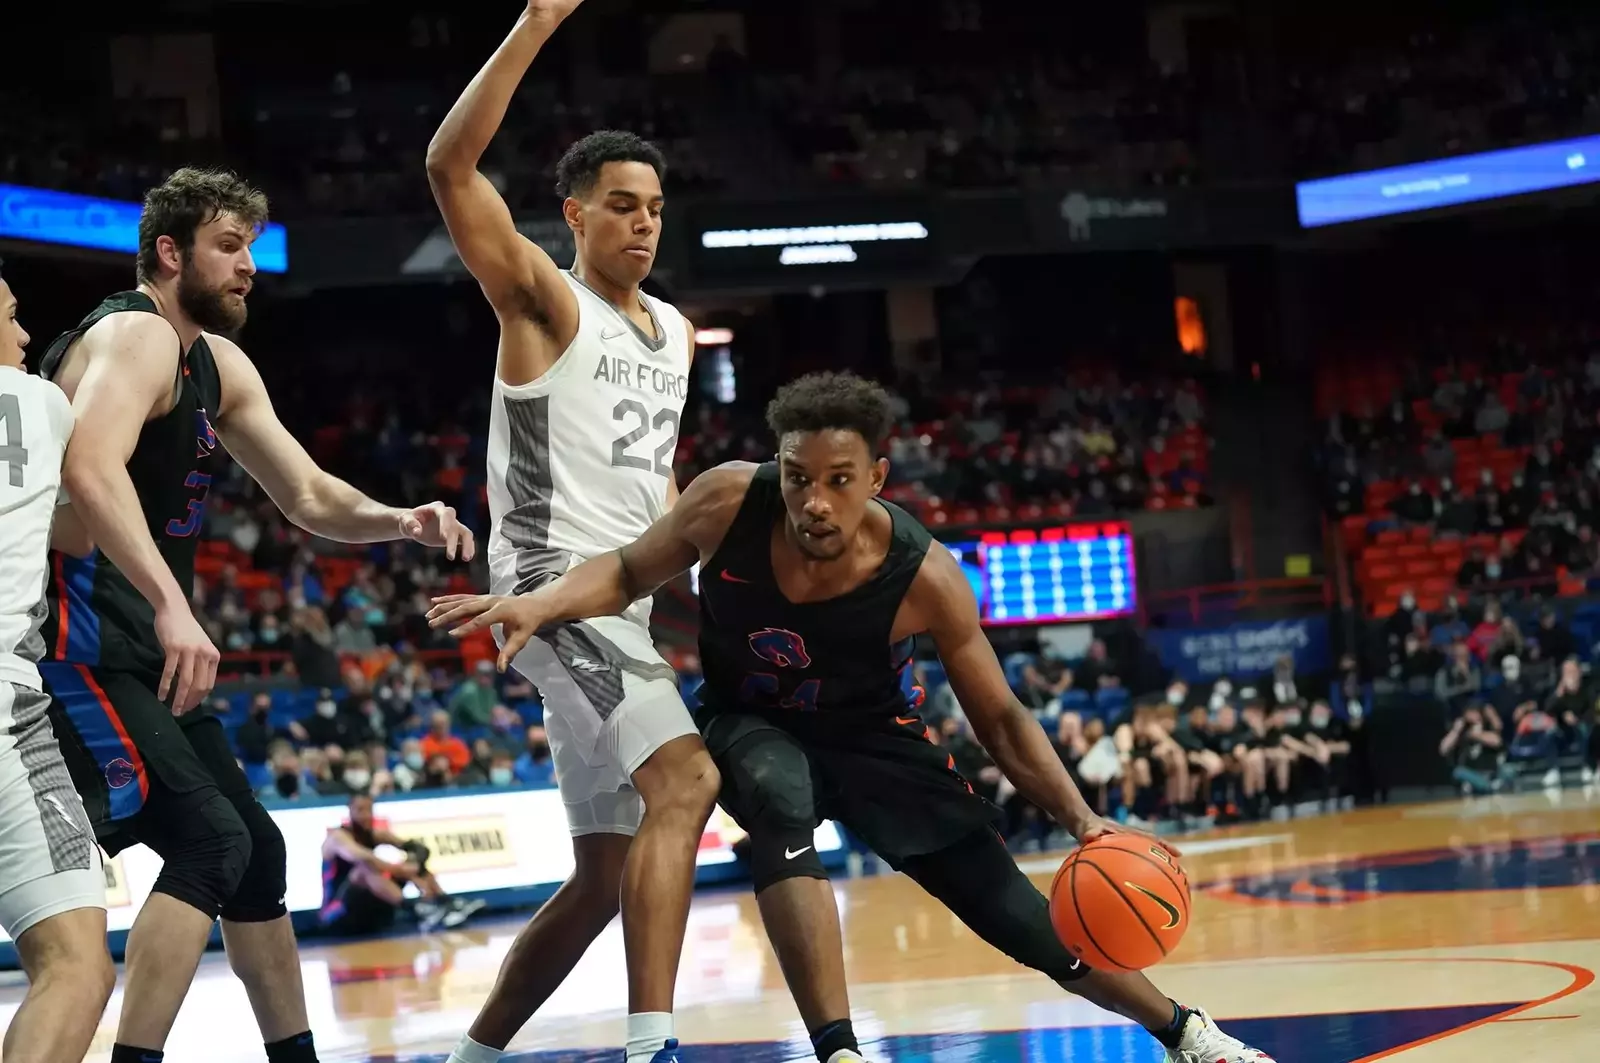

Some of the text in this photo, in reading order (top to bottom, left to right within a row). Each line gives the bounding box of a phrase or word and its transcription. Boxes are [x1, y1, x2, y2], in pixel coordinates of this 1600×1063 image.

[593, 354, 631, 387] AIR
[636, 363, 689, 401] FORC
[611, 398, 679, 479] 22
